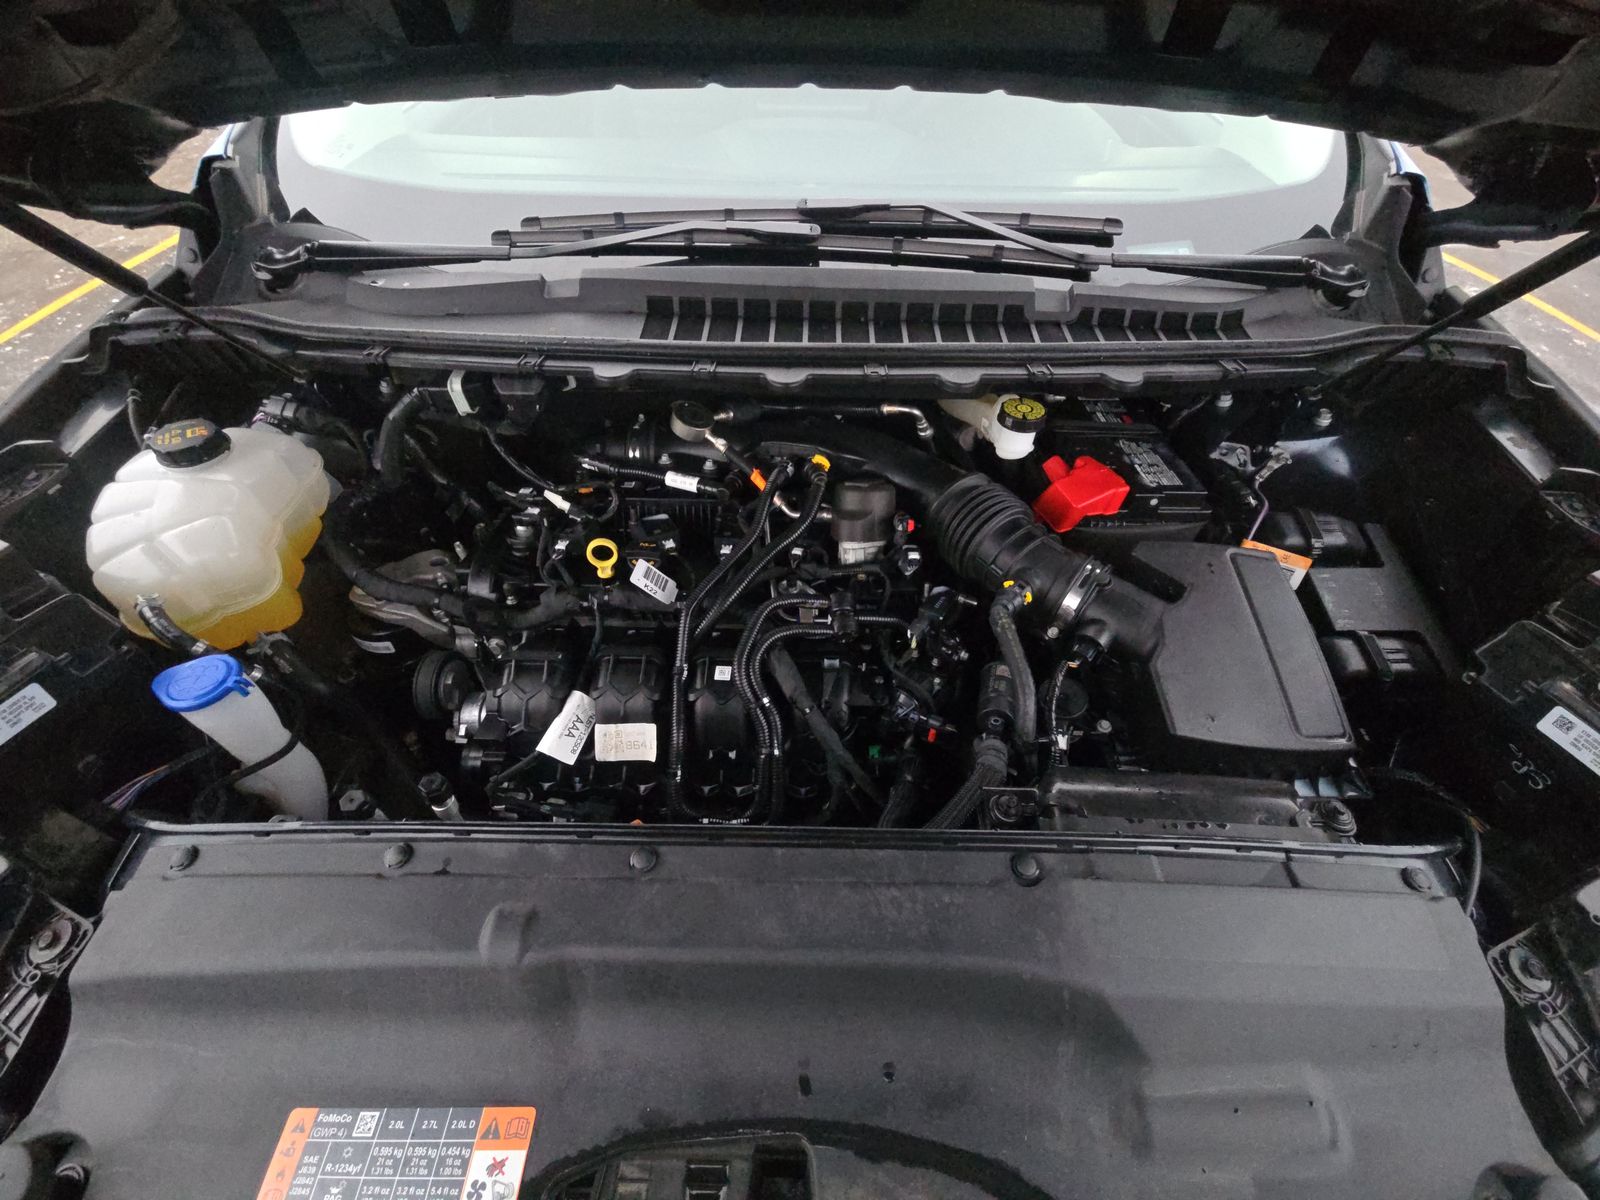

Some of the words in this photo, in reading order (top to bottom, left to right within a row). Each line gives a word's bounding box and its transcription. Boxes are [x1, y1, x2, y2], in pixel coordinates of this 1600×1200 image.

[564, 714, 584, 739] AAA
[317, 1113, 353, 1123] FoMoCo
[388, 1120, 405, 1129] 2.0L
[422, 1120, 438, 1129] 2.7L
[451, 1120, 467, 1129] 2.0L
[469, 1120, 476, 1129] D
[310, 1128, 337, 1139] (GWP
[337, 1128, 347, 1139] 4)
[373, 1147, 394, 1156] 0.595
[393, 1147, 403, 1159] kg
[407, 1147, 428, 1156] 0.595
[428, 1147, 437, 1159] kg
[441, 1147, 461, 1156] 0.454
[461, 1147, 471, 1159] kg
[303, 1155, 320, 1163] SAE
[376, 1157, 385, 1166] 21
[410, 1157, 419, 1166] 21
[445, 1157, 453, 1166] 16
[324, 1163, 362, 1175] R-1234yf
[371, 1167, 383, 1175] 1.31
[405, 1167, 418, 1175] 1.31
[361, 1186, 374, 1195] 3.2
[381, 1187, 391, 1195] oz
[396, 1186, 409, 1195] 3.2
[416, 1187, 425, 1195] oz
[430, 1187, 442, 1195] 5.4
[450, 1187, 460, 1195] oz
